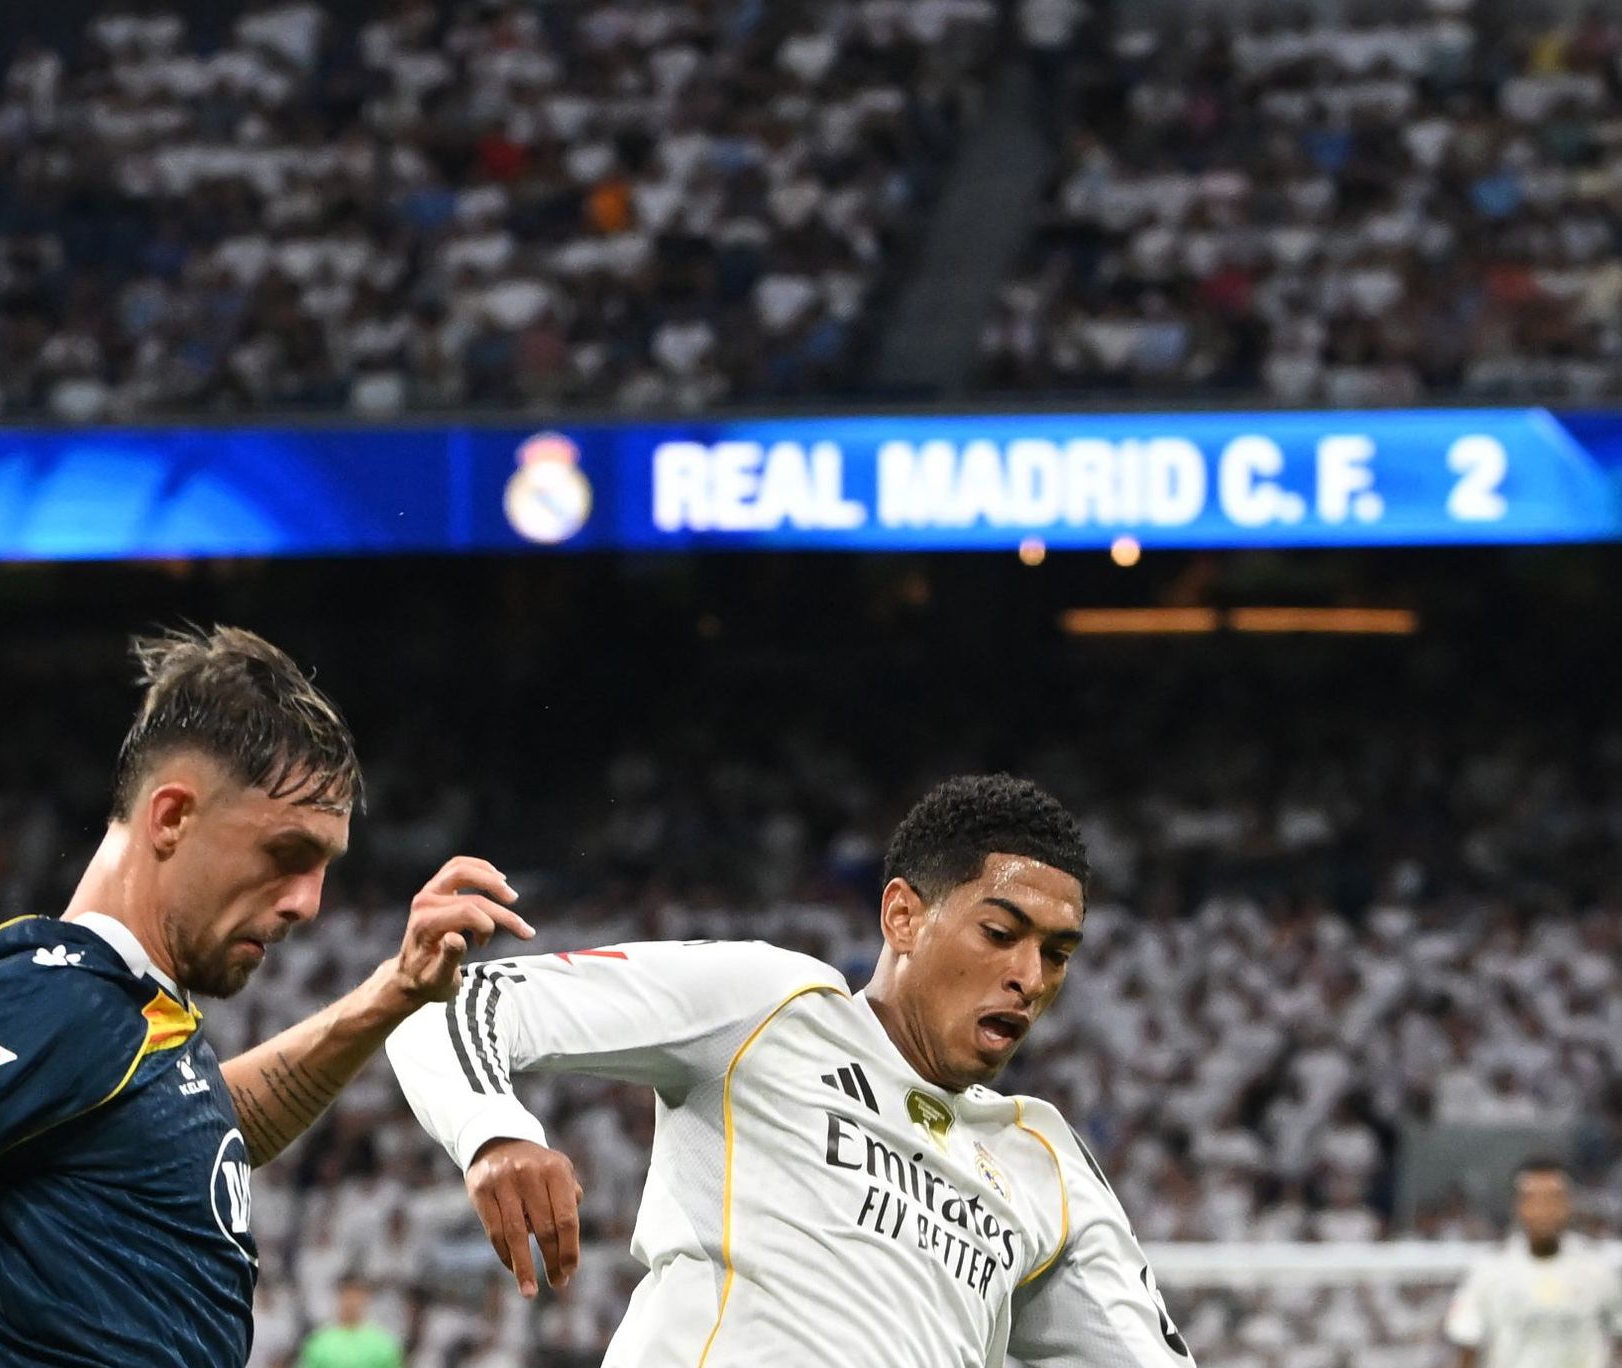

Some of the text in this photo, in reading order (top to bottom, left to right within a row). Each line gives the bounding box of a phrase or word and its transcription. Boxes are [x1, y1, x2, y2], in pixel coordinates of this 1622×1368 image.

[653, 434, 1508, 531] REAL MADRID C. F. 2
[826, 1112, 1015, 1270] Emirates
[857, 1185, 997, 1300] FLY BETTER
